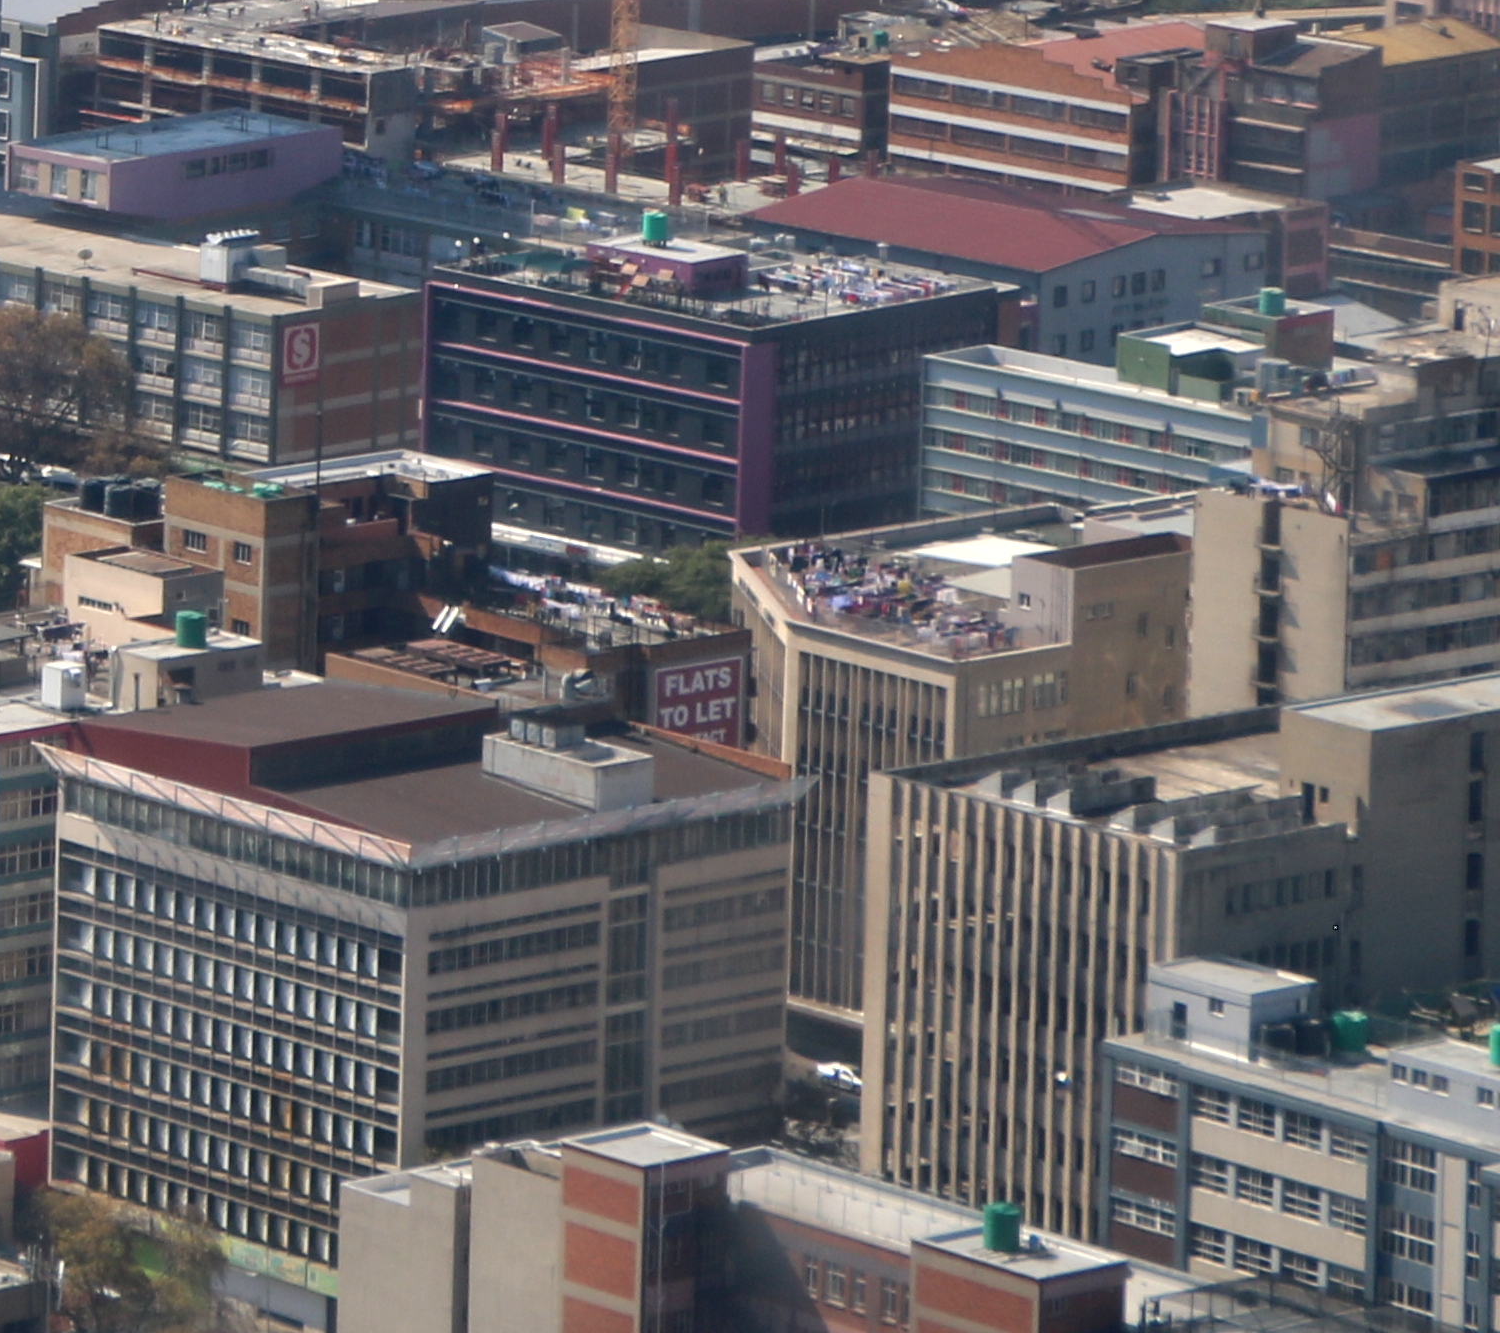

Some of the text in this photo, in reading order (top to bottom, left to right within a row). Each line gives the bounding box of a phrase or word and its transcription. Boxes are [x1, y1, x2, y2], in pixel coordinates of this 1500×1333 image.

[665, 667, 732, 697] FLATS
[659, 696, 736, 729] TO LET
